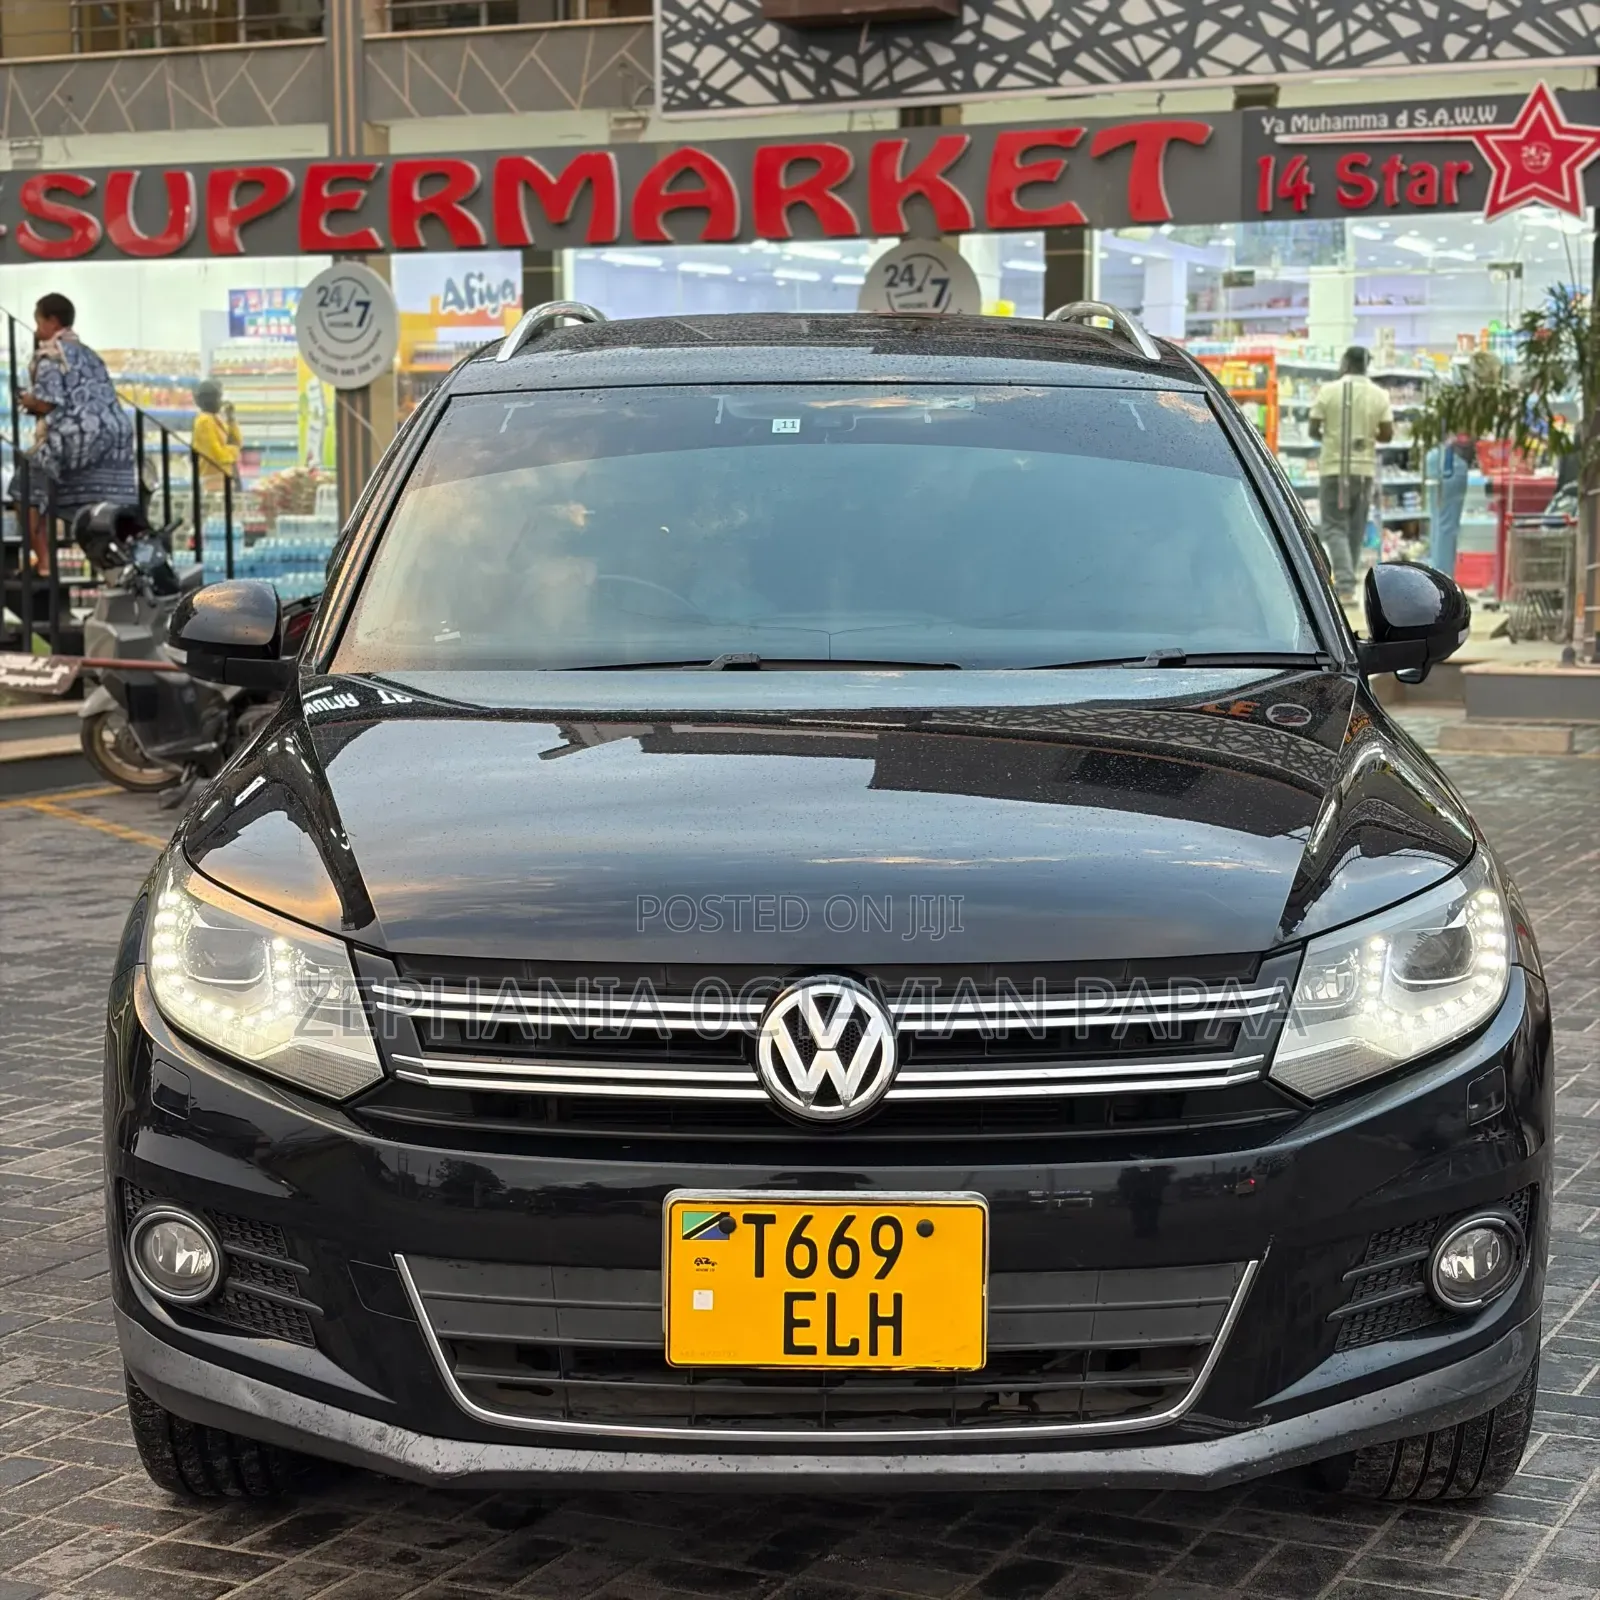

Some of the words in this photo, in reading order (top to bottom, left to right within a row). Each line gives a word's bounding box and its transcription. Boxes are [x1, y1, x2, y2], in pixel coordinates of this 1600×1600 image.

[1261, 116, 1285, 134] Ya
[15, 120, 1214, 259] SUPERMARKET
[1257, 154, 1315, 213] 14
[1335, 153, 1474, 209] Star
[441, 271, 517, 315] Afiya
[742, 1213, 904, 1280] T669
[783, 1291, 903, 1357] ELH
